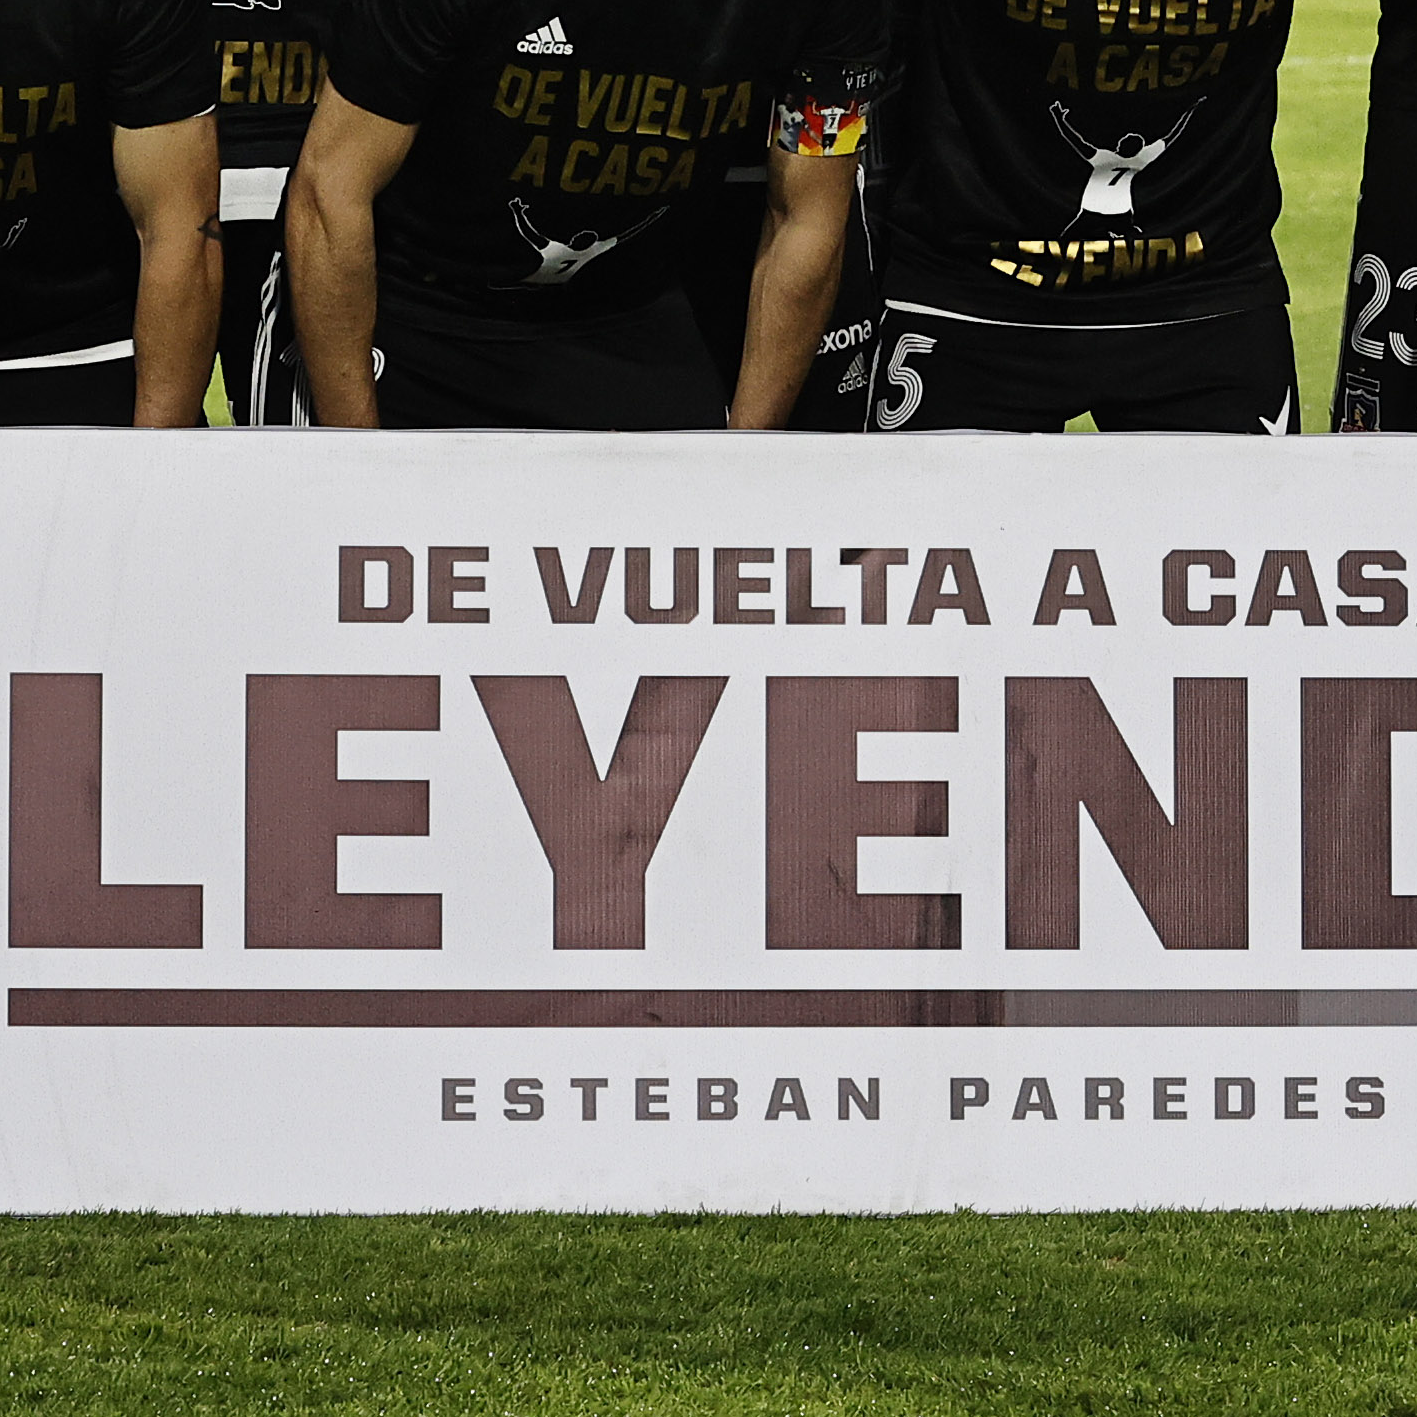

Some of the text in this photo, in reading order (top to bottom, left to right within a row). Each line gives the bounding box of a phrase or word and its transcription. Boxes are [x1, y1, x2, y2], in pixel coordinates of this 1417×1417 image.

[516, 40, 574, 56] adidas
[1045, 41, 1230, 93] A CASA
[492, 63, 753, 142] DE VUELTA
[509, 135, 697, 197] A CASA
[1108, 167, 1132, 187] 7
[876, 332, 938, 431] 5
[338, 545, 491, 624] DE
[533, 546, 992, 626] VUELTA
[1033, 548, 1117, 626] A
[441, 1077, 1387, 1122] ESTEBAN PAREDES
